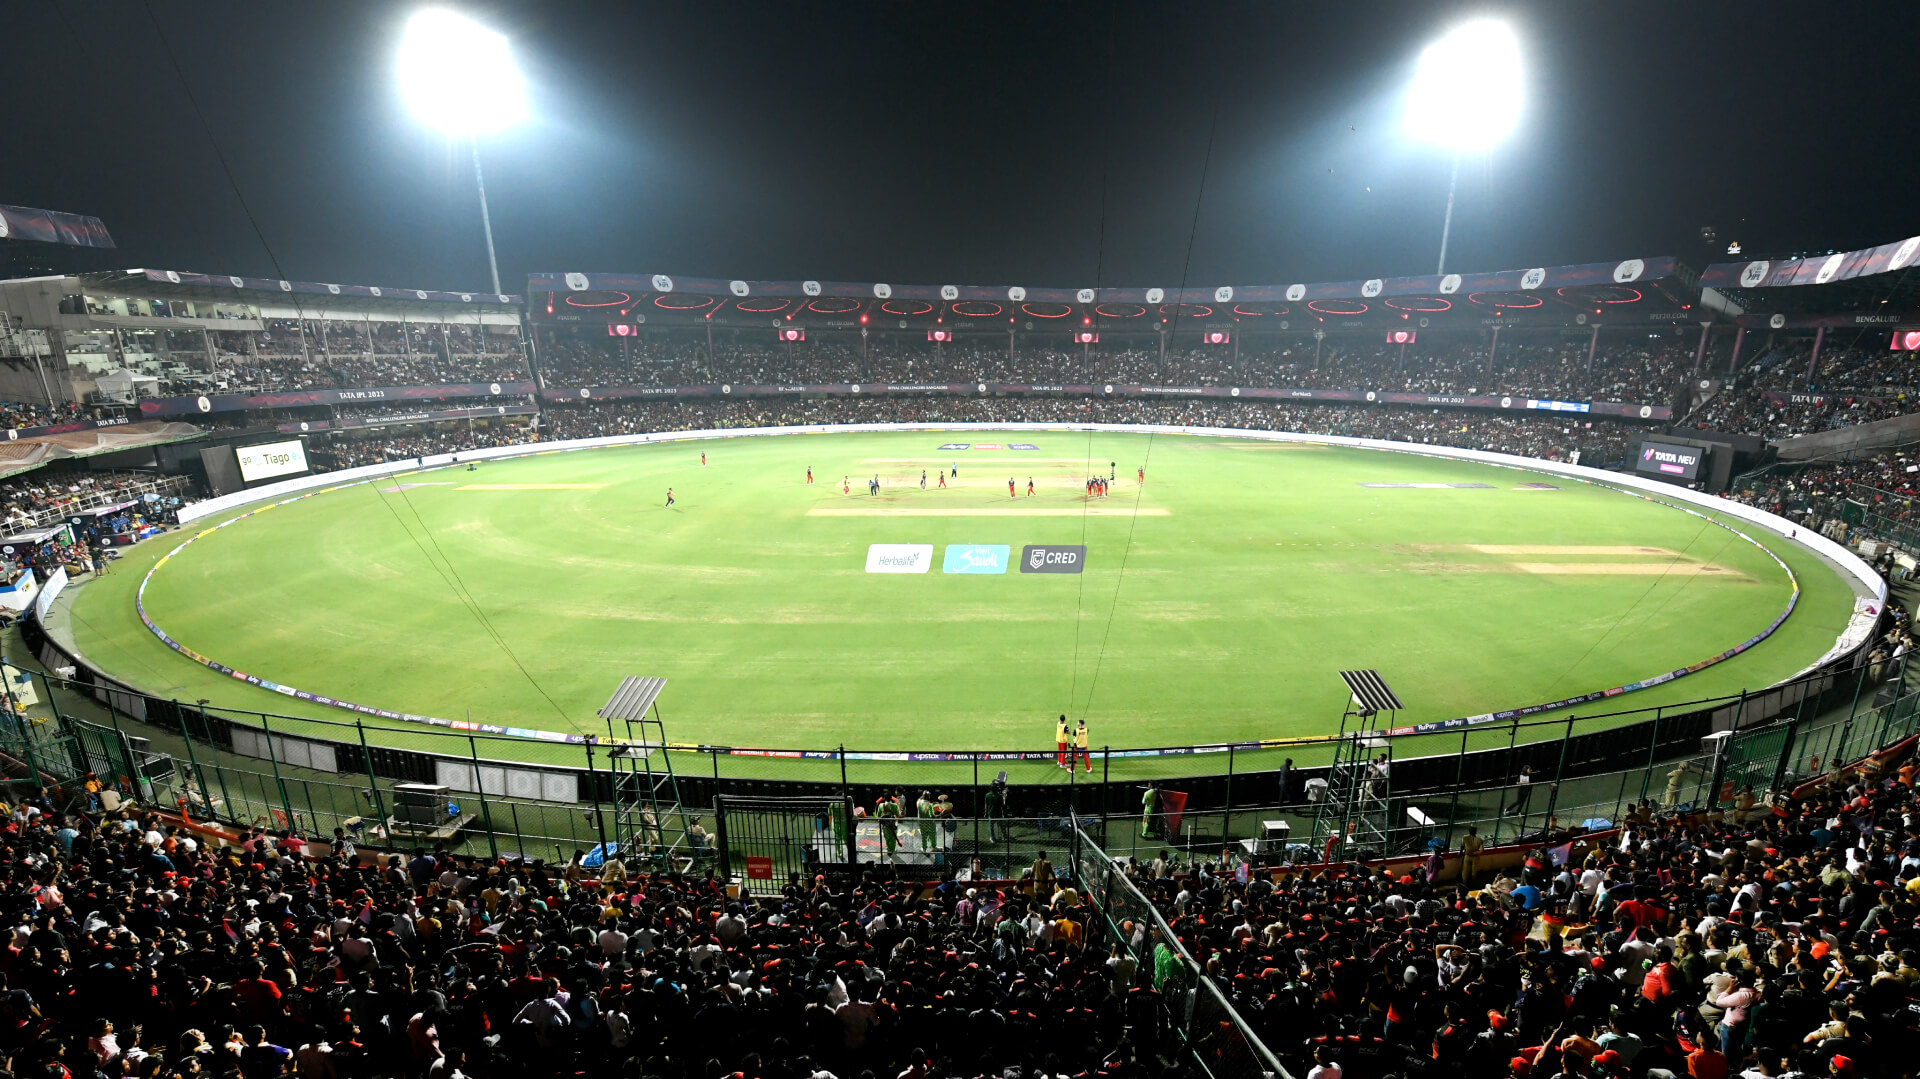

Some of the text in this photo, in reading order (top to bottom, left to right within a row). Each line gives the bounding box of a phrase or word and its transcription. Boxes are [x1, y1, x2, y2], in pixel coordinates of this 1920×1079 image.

[1791, 395, 1810, 403] TATA
[263, 453, 290, 466] Tiago
[1655, 451, 1696, 465] TATA NEU
[878, 555, 915, 566] Herbalife
[952, 550, 998, 572] Saudi
[1046, 552, 1077, 564] CRED
[1444, 719, 1462, 727] RuPay
[915, 752, 939, 760] upstox
